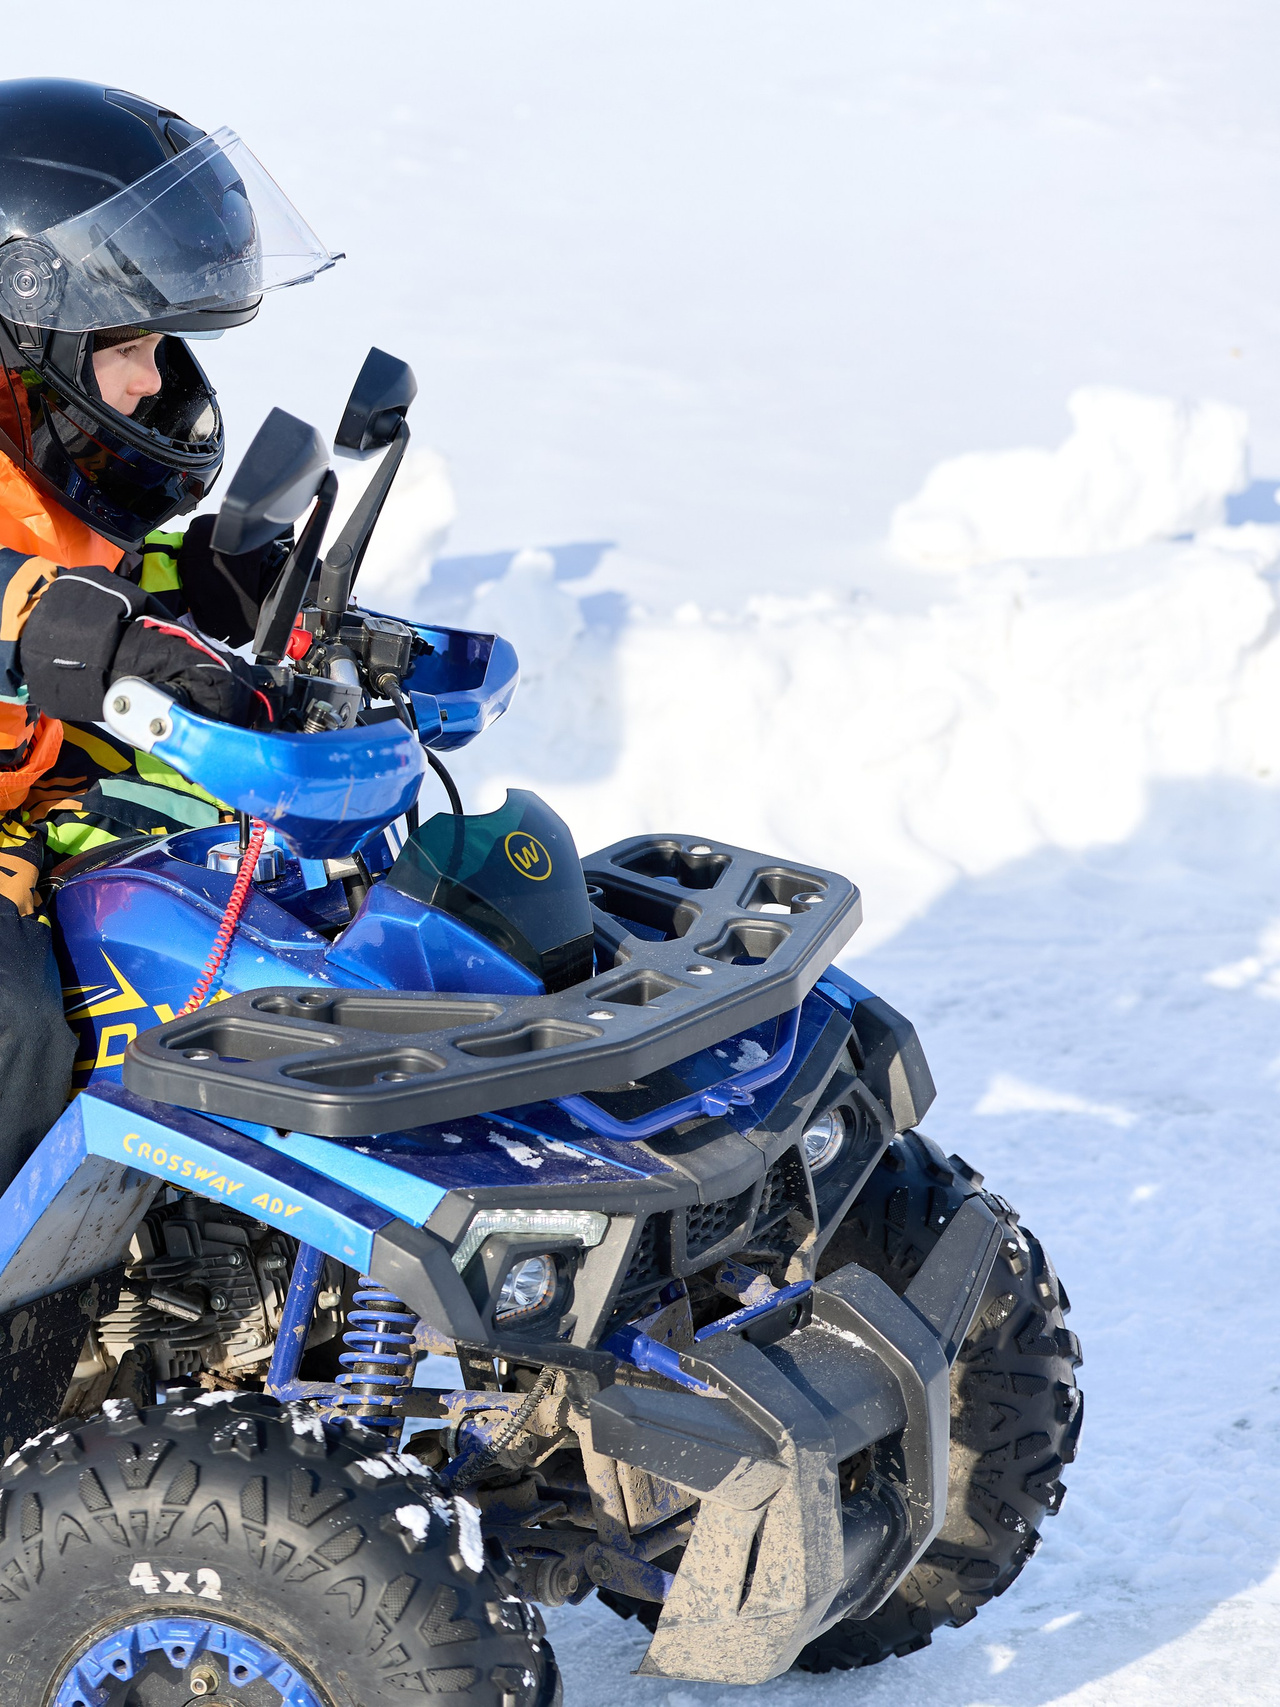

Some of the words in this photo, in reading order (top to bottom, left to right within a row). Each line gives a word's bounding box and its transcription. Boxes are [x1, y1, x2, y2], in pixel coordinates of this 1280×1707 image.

[513, 841, 540, 871] W
[123, 1133, 245, 1196] CROSSWAY
[251, 1192, 304, 1218] ADV
[128, 1562, 223, 1601] 4x2
